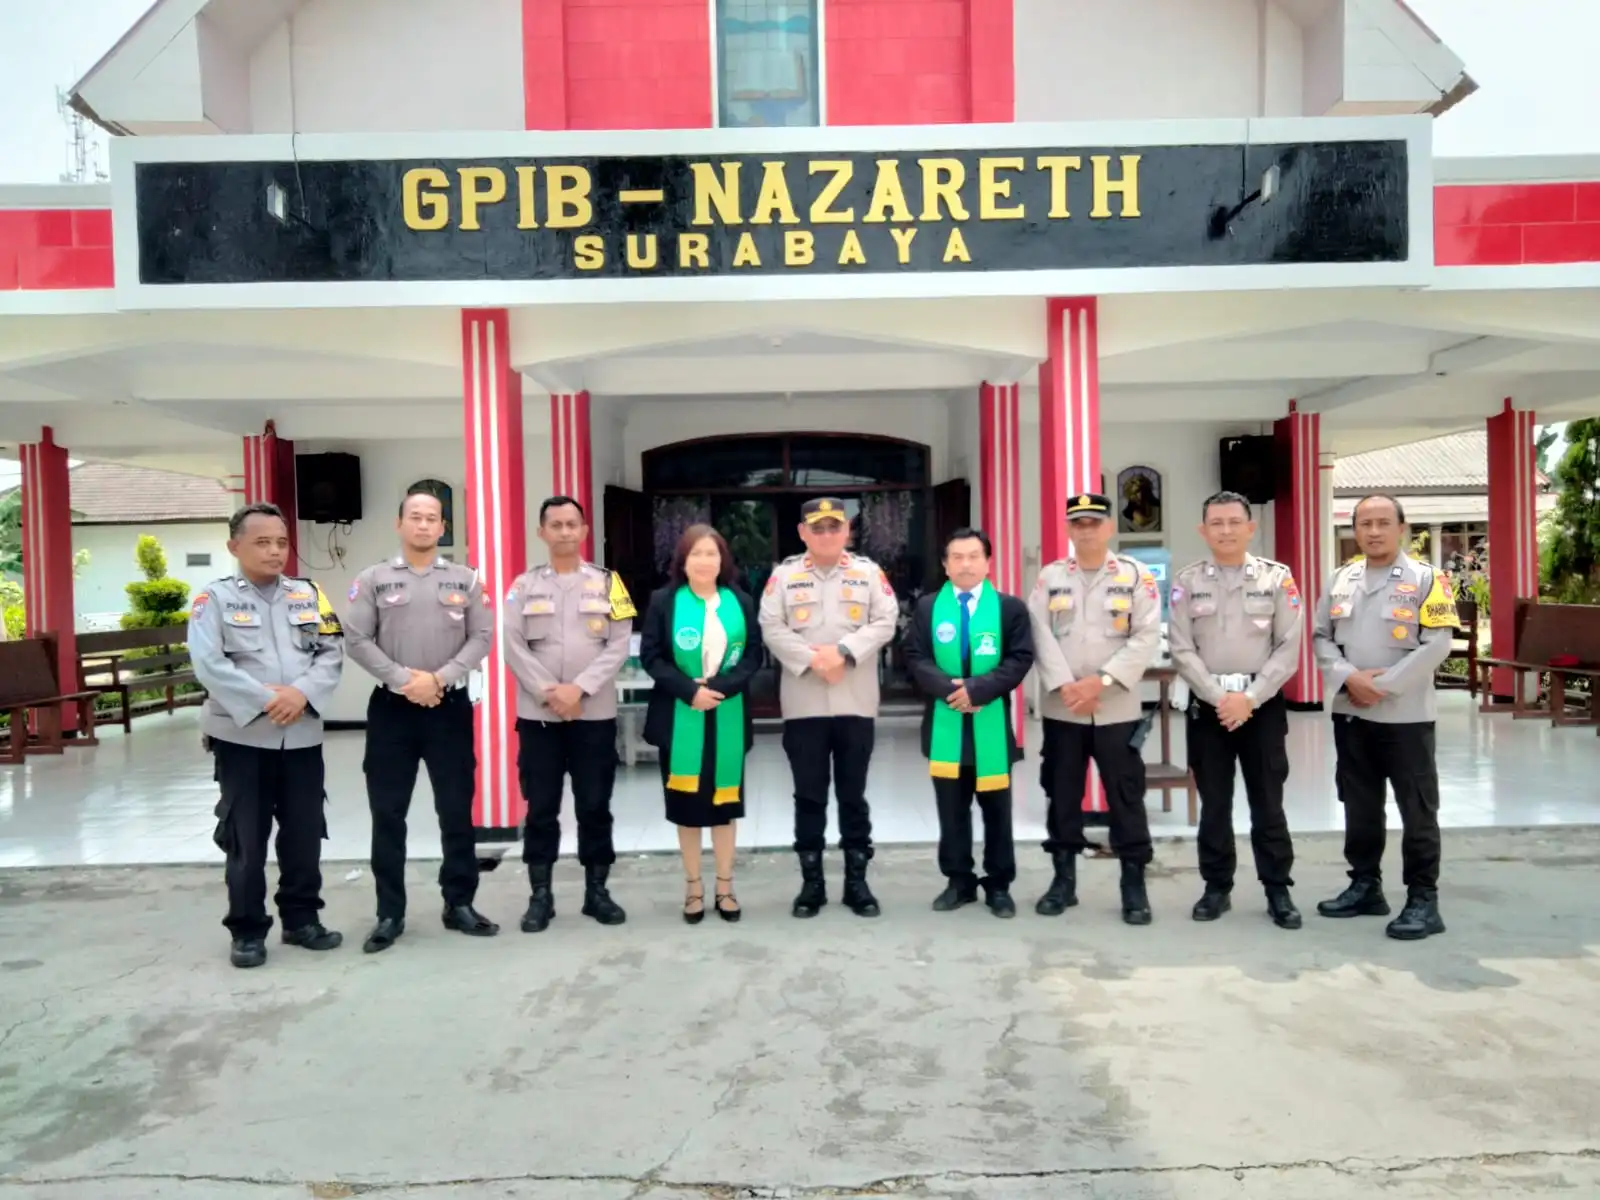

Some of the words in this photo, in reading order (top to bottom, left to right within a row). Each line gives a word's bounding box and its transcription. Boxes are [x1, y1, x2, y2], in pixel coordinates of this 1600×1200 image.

[403, 166, 591, 229] GPIB
[693, 155, 1139, 224] NAZARETH
[574, 228, 970, 269] SURABAYA
